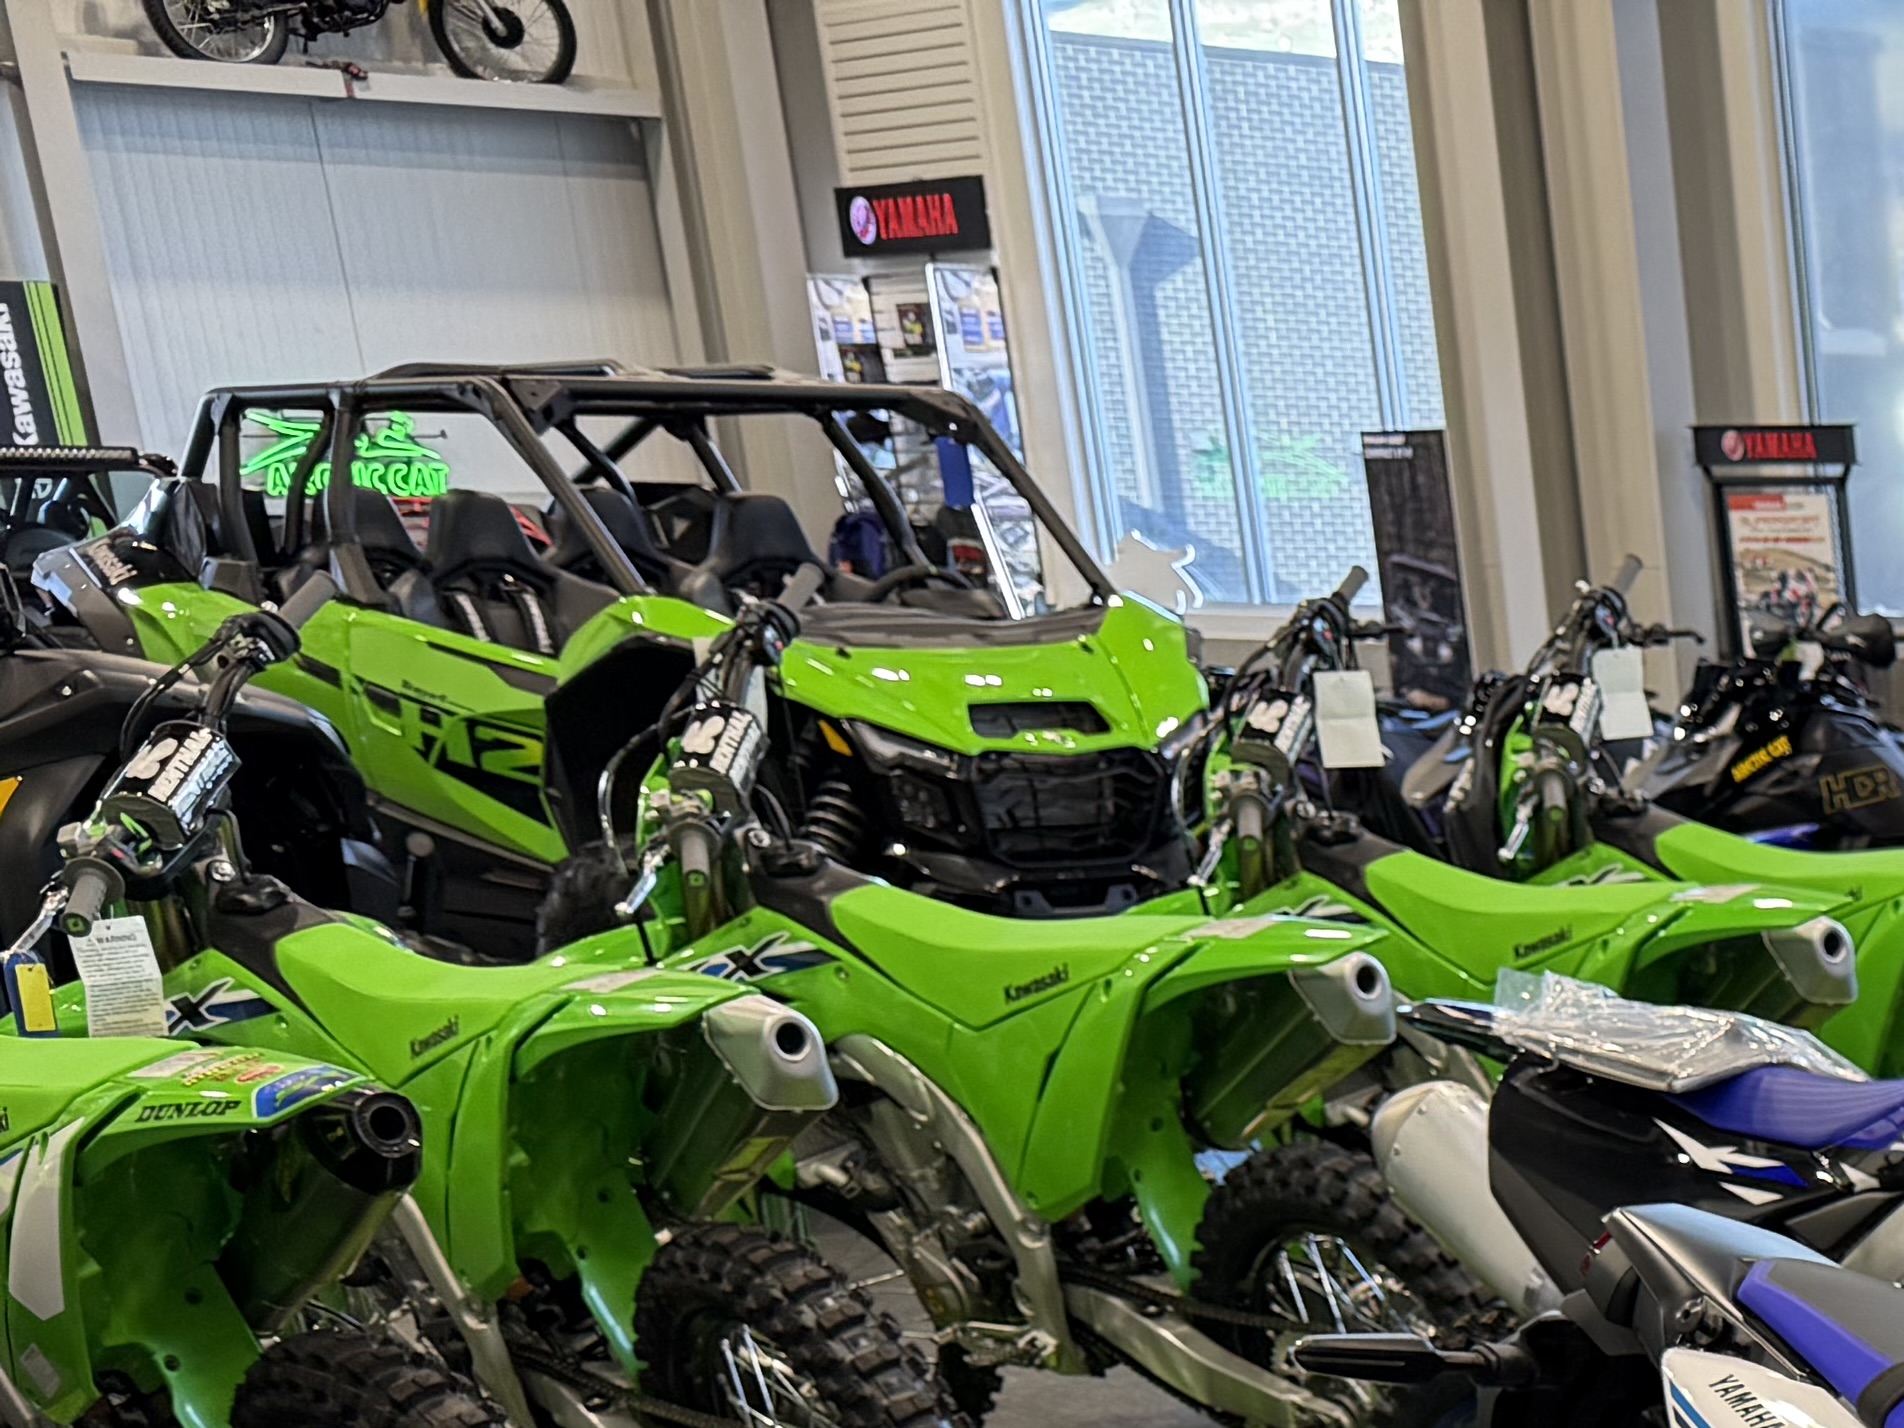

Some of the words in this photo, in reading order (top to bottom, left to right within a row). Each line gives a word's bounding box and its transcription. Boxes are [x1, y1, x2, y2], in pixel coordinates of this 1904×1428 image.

[872, 193, 959, 240] YAMAHA
[1744, 432, 1818, 460] YAMAHA
[384, 462, 449, 497] CAT
[1003, 962, 1071, 1007] Kawasaki
[135, 1099, 241, 1123] DUNLOP
